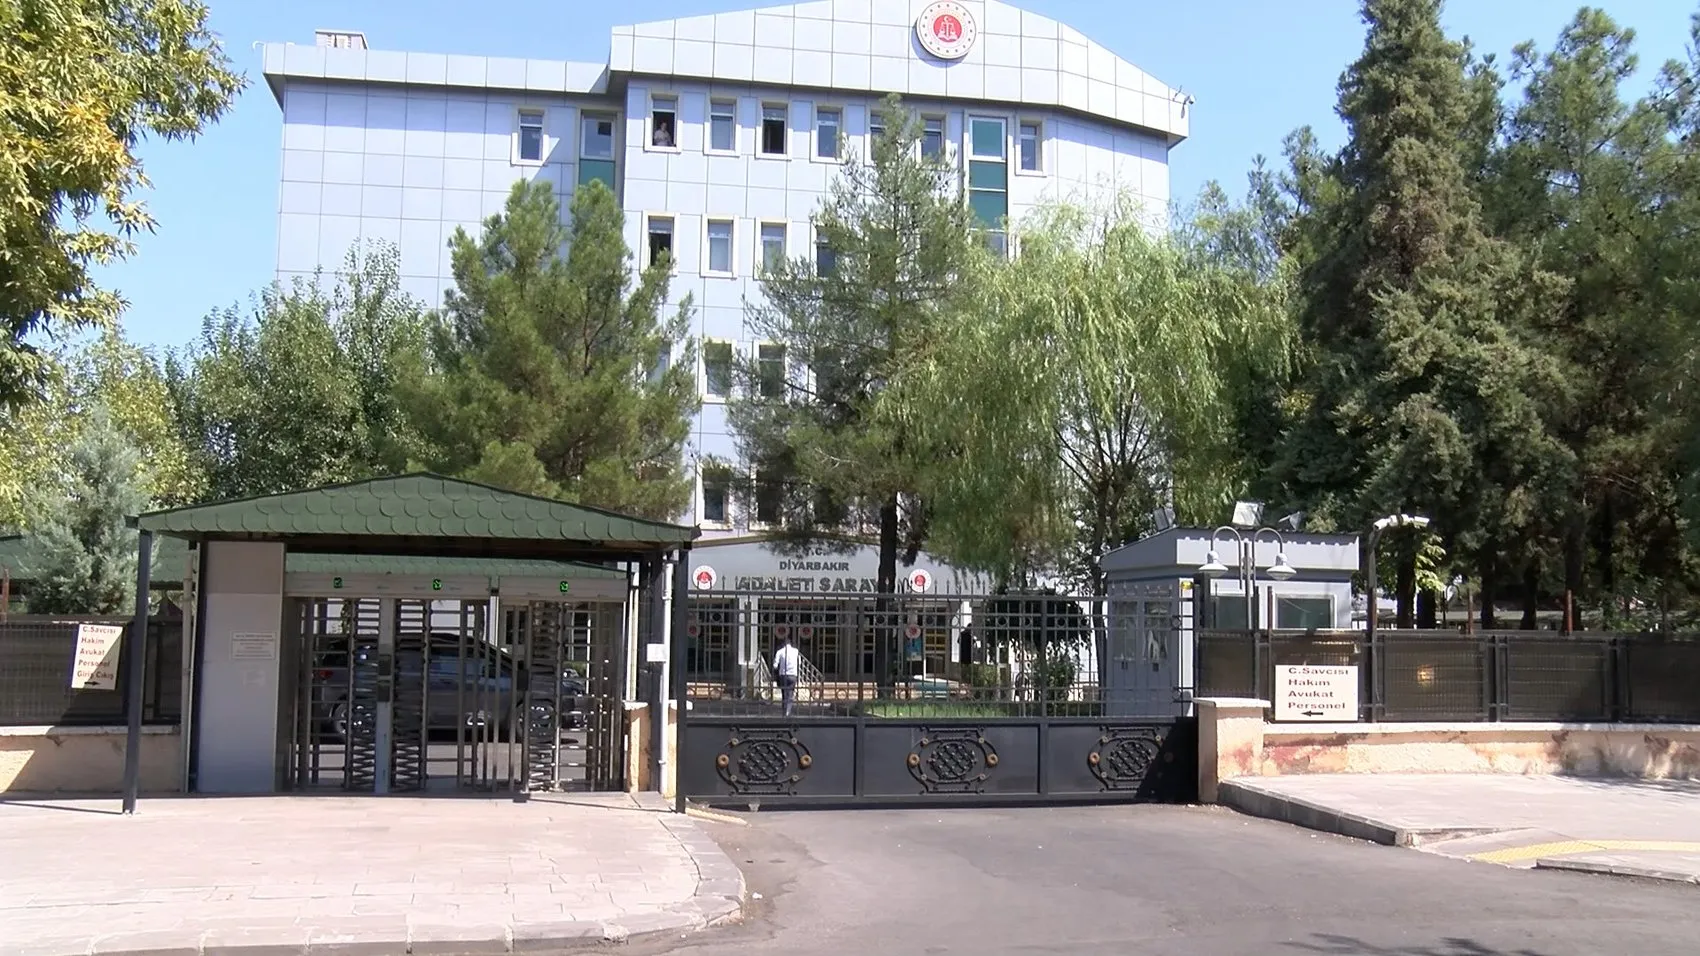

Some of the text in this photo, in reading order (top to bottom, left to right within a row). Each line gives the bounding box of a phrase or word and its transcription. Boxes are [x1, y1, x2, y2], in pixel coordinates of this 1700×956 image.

[779, 559, 849, 571] DİYARBAKIR
[736, 576, 880, 592] ADALET SARAY
[1288, 690, 1334, 698] Avukat
